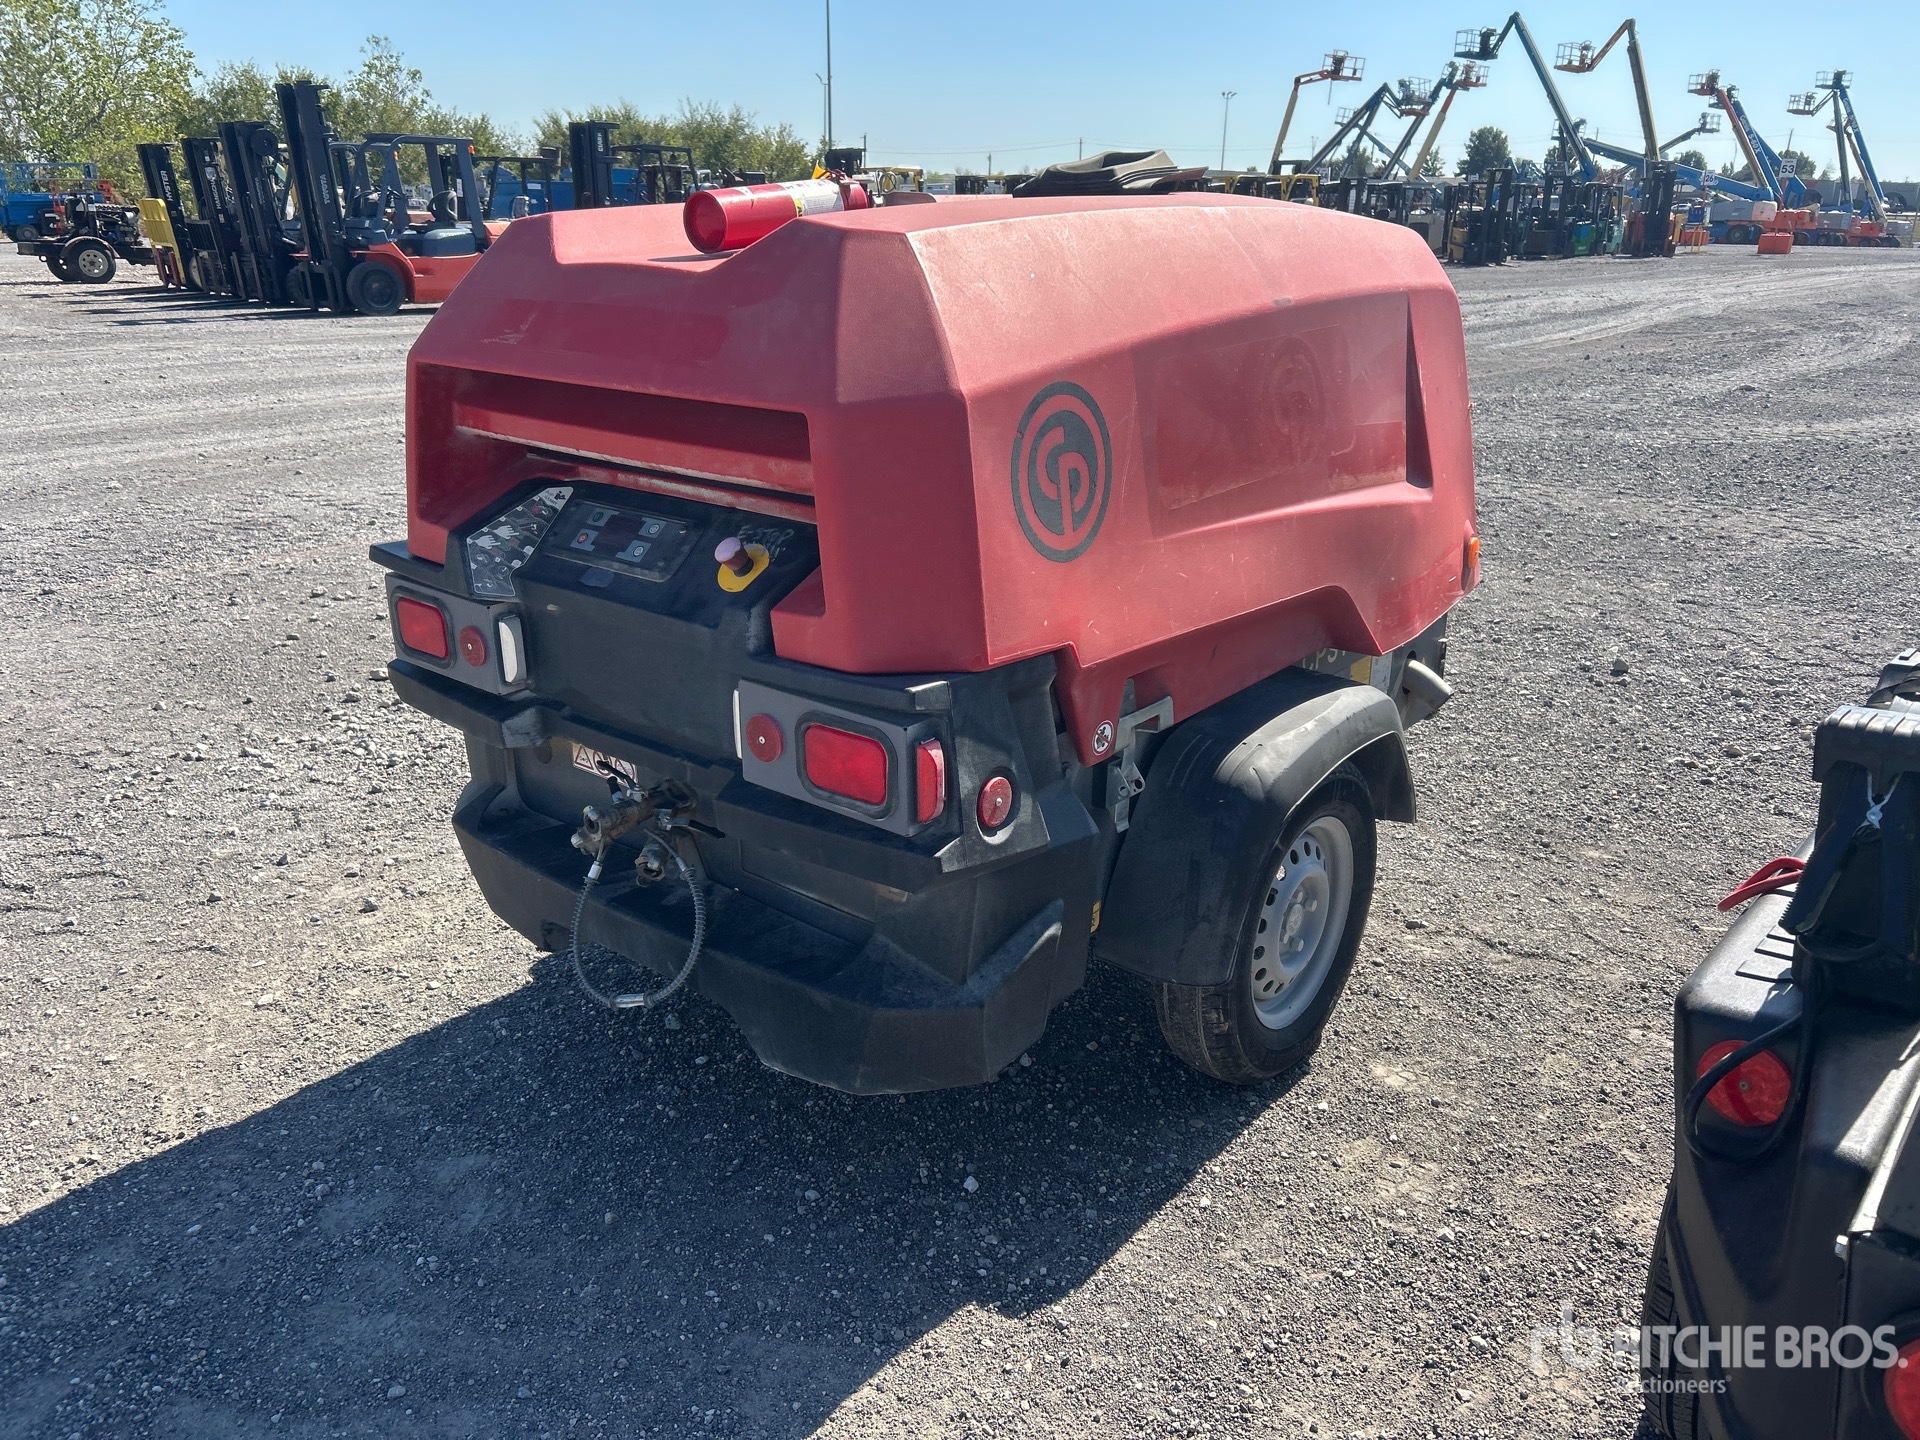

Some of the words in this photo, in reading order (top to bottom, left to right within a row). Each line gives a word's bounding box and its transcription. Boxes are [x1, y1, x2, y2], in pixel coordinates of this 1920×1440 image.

[1781, 164, 1795, 174] 53
[160, 170, 173, 201] HYSTER
[320, 173, 331, 205] TOYOTA
